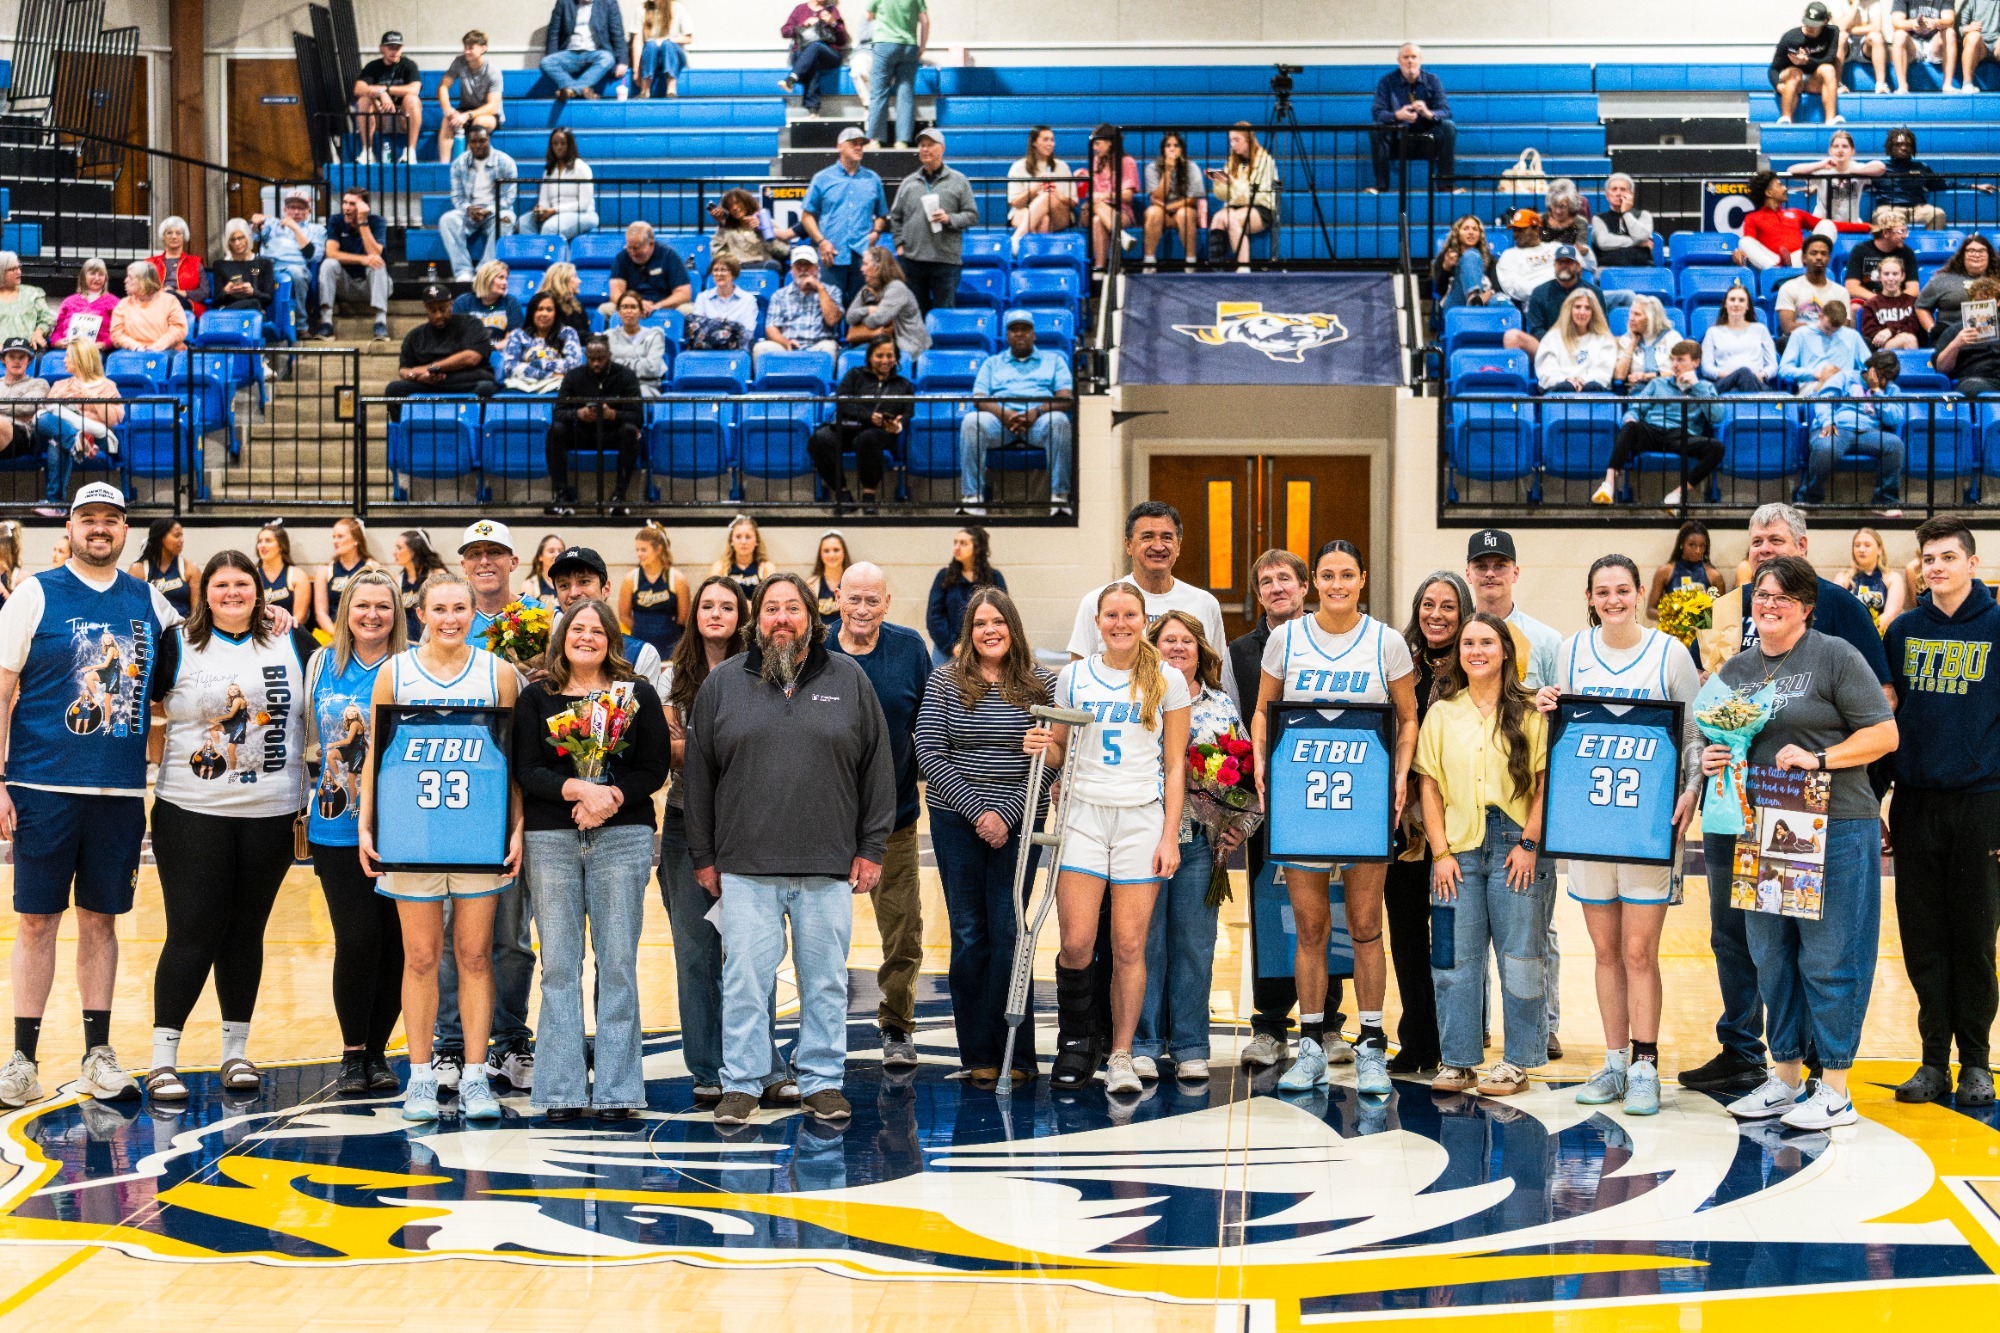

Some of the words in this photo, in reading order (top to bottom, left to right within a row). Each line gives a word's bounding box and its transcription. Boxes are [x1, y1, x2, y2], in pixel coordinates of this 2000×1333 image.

[773, 187, 807, 198] SECTI
[1715, 184, 1752, 194] SECTI
[1714, 195, 1755, 238] C
[65, 617, 110, 635] Tiffany
[1903, 637, 1992, 681] ETBU
[130, 619, 154, 734] BICKFORD
[1295, 670, 1371, 693] ETBU
[1909, 677, 1968, 694] TIGERS
[262, 665, 291, 773] BICKFORD
[402, 738, 484, 762] ETBU
[1102, 730, 1121, 765] 5
[1291, 739, 1369, 764] ETBU
[1574, 734, 1659, 761] ETBU
[1769, 766, 1788, 778] little
[1789, 771, 1805, 781] girl
[416, 769, 469, 809] 33
[1306, 770, 1353, 811] 22
[1588, 766, 1640, 808] 32
[1762, 781, 1777, 793] had
[1787, 785, 1800, 796] big
